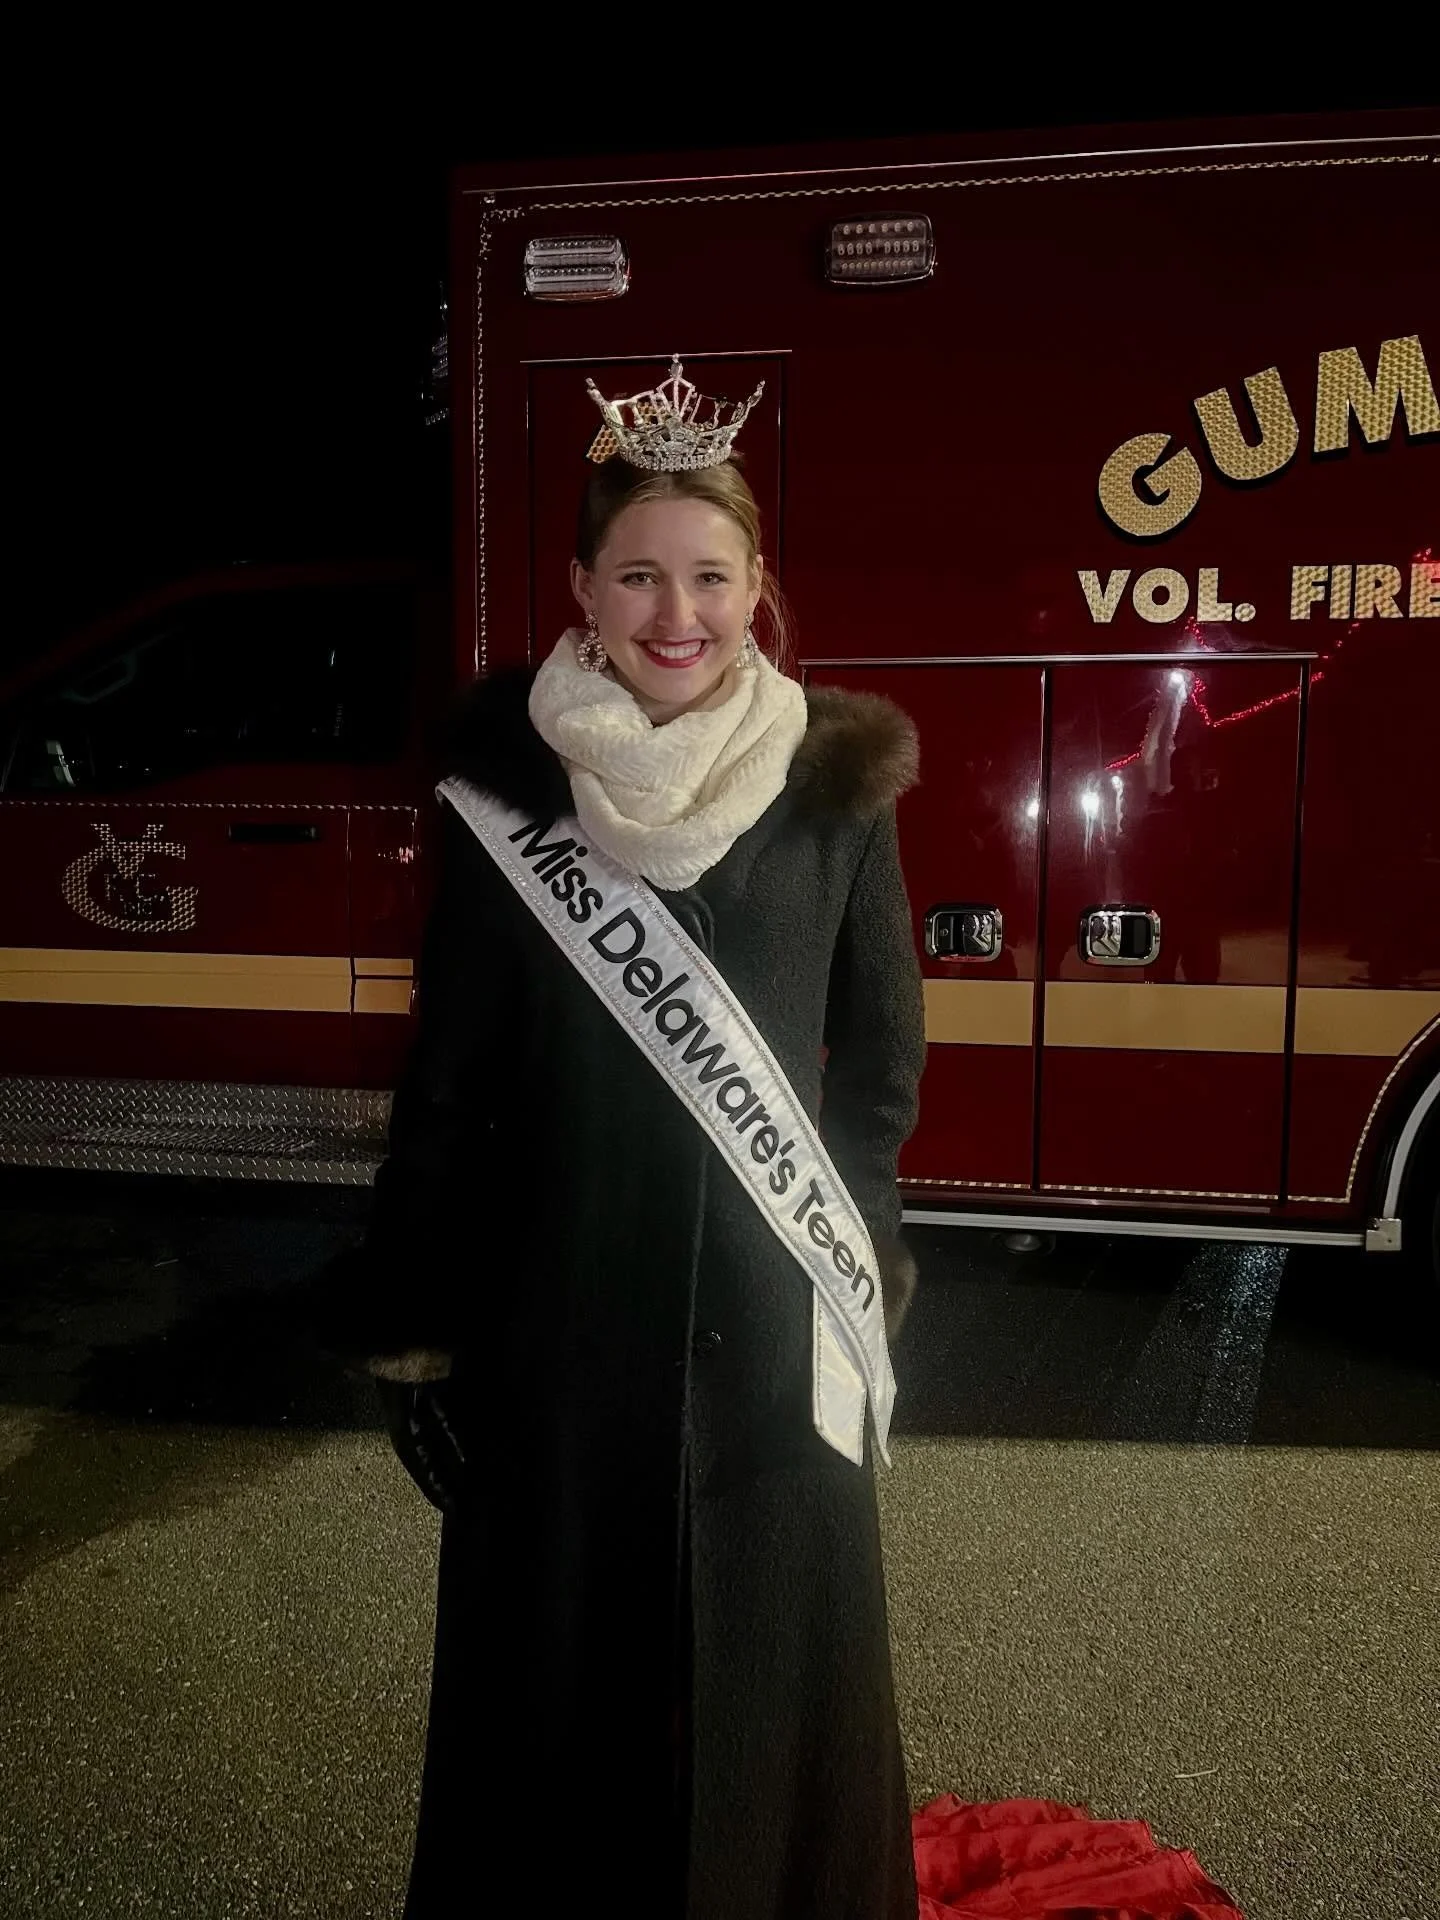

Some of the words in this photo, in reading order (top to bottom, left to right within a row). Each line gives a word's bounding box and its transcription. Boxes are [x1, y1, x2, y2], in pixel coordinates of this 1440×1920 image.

[1099, 335, 1440, 536] GUM
[1077, 567, 1256, 623] VOL.
[1290, 563, 1440, 620] FIRE
[508, 818, 603, 924] Miss
[588, 907, 796, 1195] Delaware's
[793, 1178, 875, 1312] Teen
